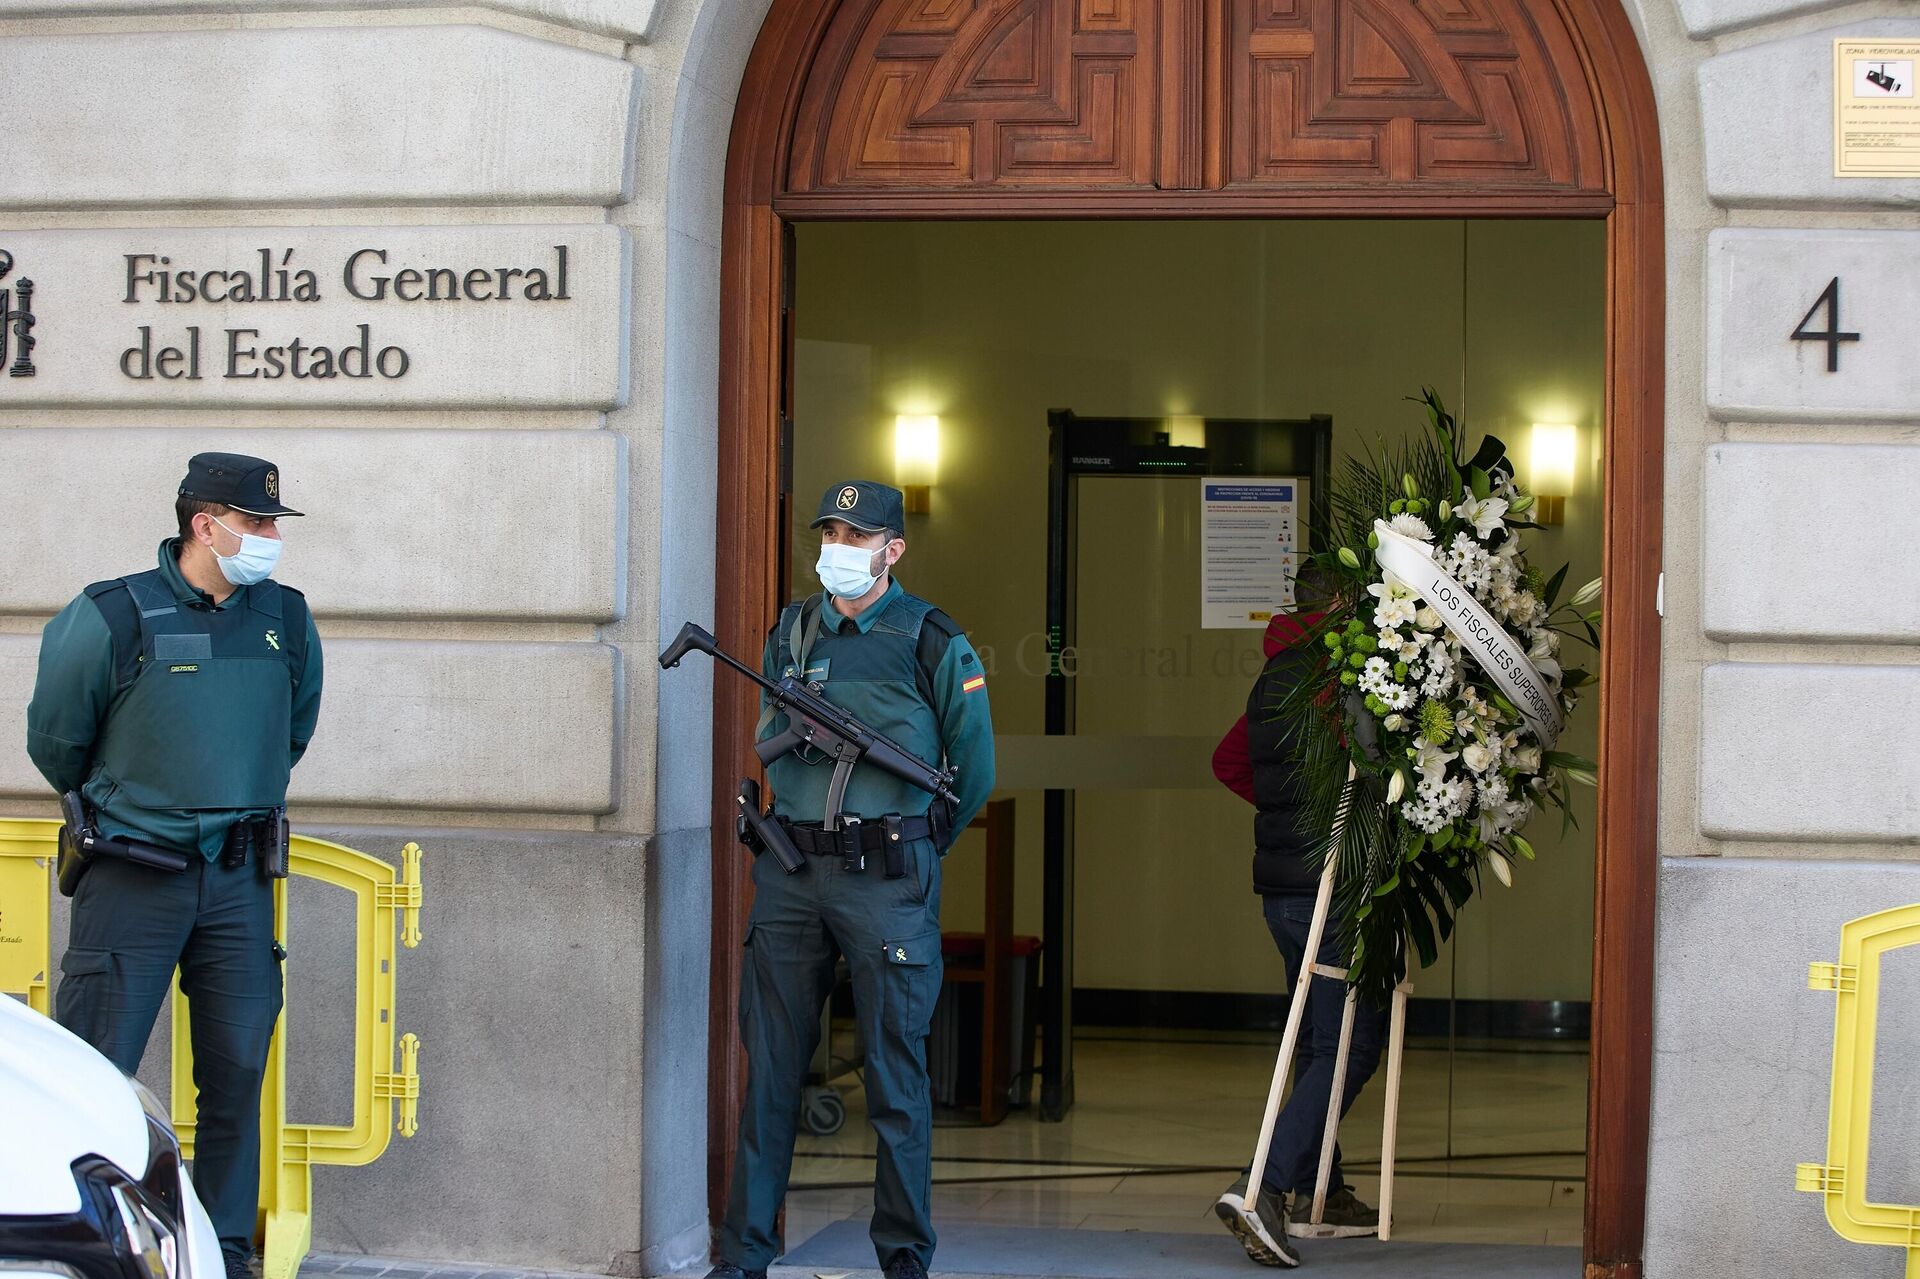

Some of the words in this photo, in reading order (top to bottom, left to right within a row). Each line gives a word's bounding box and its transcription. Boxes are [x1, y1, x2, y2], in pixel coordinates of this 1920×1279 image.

[121, 247, 321, 304] Fiscalía
[343, 244, 573, 302] General
[119, 325, 203, 380] del
[223, 323, 411, 380] Estado
[1790, 276, 1860, 372] 4
[1016, 630, 1194, 678] Geeral
[1431, 579, 1460, 611] LOS
[1457, 607, 1514, 671] FISCALES
